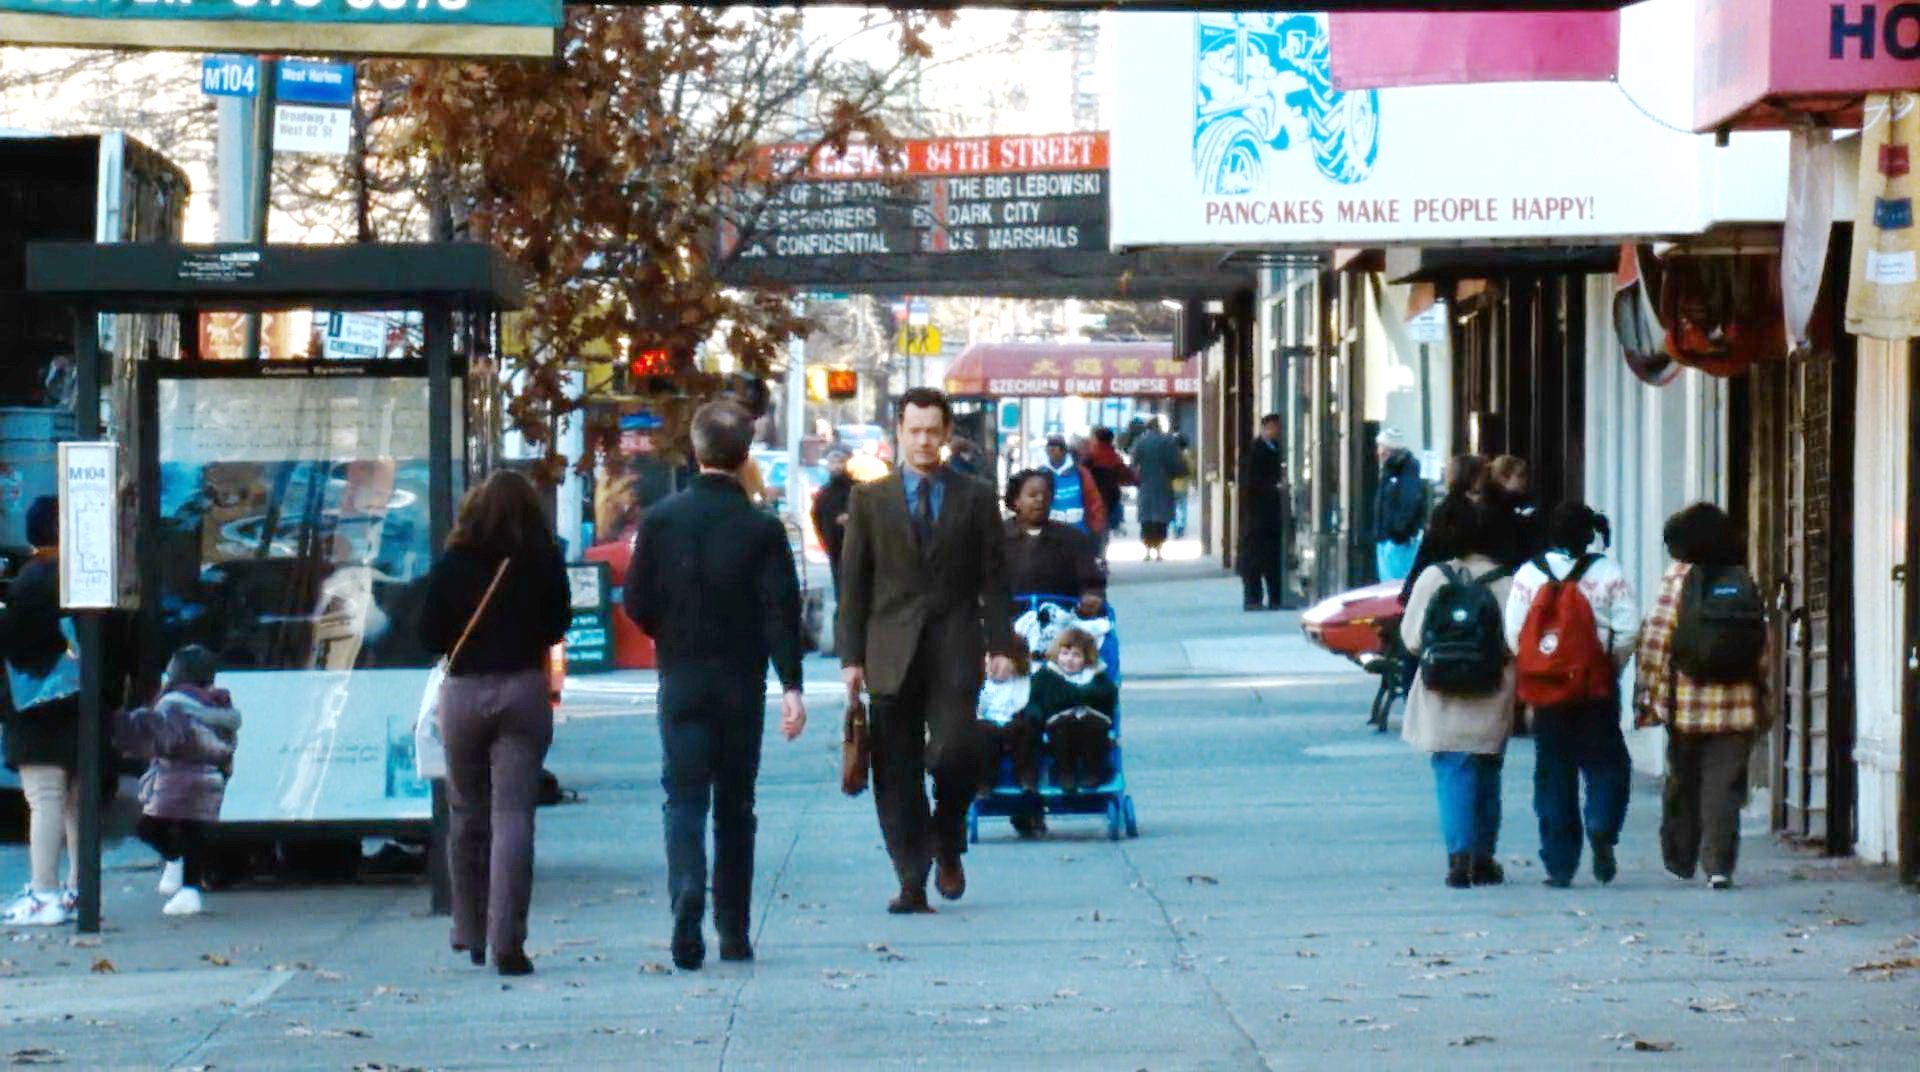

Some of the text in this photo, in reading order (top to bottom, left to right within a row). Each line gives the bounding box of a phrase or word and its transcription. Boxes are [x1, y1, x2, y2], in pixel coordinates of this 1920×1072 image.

[204, 63, 255, 92] M104
[282, 68, 306, 82] West
[279, 109, 337, 125] Broadway &
[279, 124, 333, 138] West 82 St
[926, 140, 991, 171] 84TH
[1000, 136, 1096, 168] STREET
[790, 184, 811, 204] OF
[949, 177, 981, 199] THE
[985, 176, 1012, 198] BIG
[1016, 173, 1101, 197] LEBOWSKI
[949, 202, 993, 226] DARK
[1003, 201, 1042, 224] CITY
[1205, 197, 1595, 225] PANCAKES MAKE PEOPLE HAPPY!
[776, 232, 890, 256] CONFIDENTIAL
[988, 226, 1079, 250] MARSHALS
[989, 379, 1060, 394] SZECHUAN
[1110, 378, 1169, 393] CHINESE
[69, 466, 106, 480] M104
